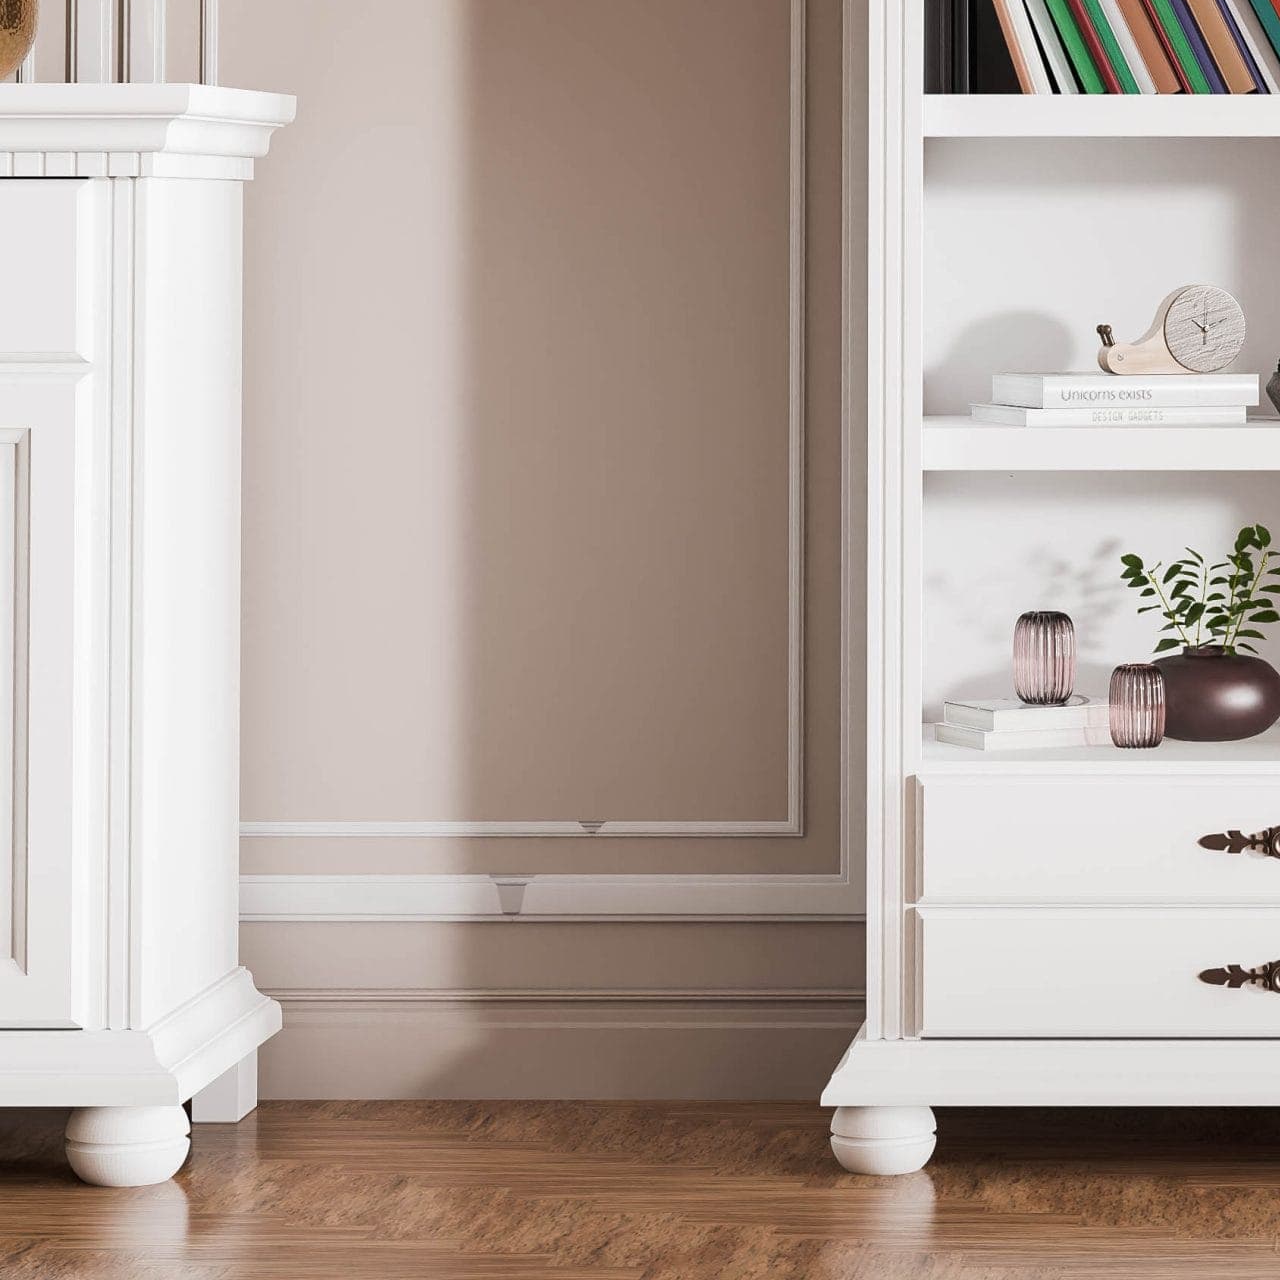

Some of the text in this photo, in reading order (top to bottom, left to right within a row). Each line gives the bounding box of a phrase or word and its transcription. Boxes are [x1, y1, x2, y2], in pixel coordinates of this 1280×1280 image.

[1061, 388, 1152, 401] Unicorns exists
[1092, 410, 1164, 422] DESIGN GADGETS
